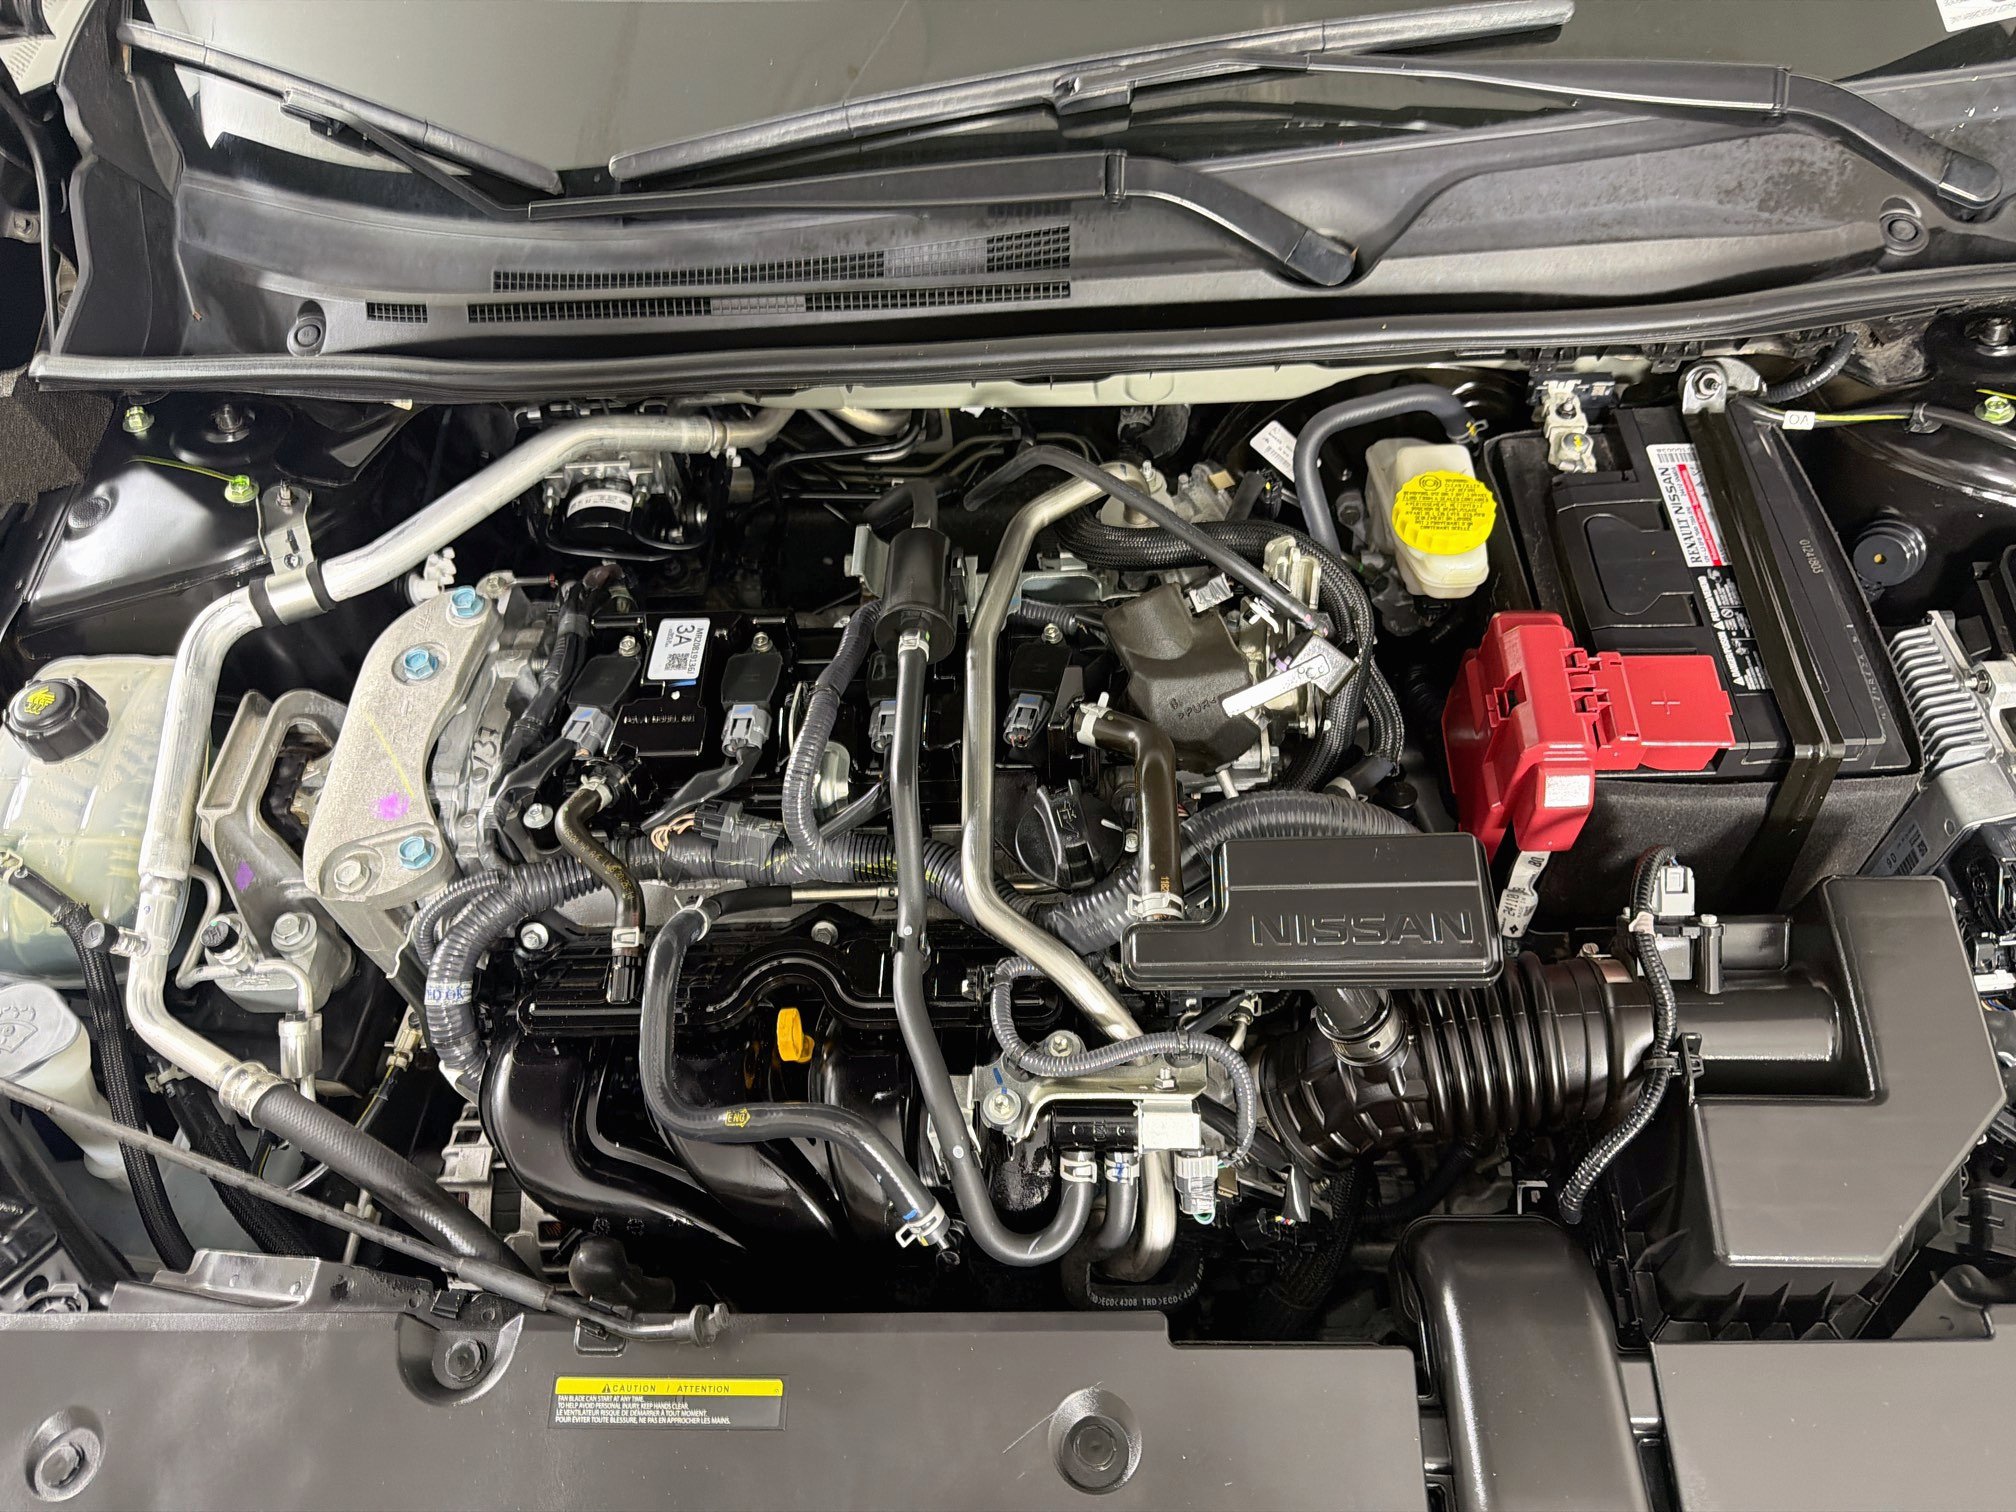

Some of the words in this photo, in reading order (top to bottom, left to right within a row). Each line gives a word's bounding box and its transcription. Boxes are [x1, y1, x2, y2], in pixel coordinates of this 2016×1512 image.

[1658, 467, 1685, 515] NISSAN
[1677, 518, 1702, 564] RENAULT
[673, 624, 695, 647] 3A
[1250, 910, 1475, 946] NISSAN
[612, 1384, 656, 1393] CAUTION
[676, 1385, 730, 1393] ATTENTION
[565, 1402, 579, 1410] HELP
[579, 1402, 595, 1410] AVOID
[595, 1402, 620, 1410] PERSONAL
[641, 1402, 653, 1410] KEEP
[653, 1402, 671, 1410] HANDS
[555, 1416, 571, 1424] POUR
[591, 1416, 609, 1424] TOUTE
[647, 1416, 658, 1424] PAS
[667, 1416, 700, 1424] APPROCHER
[701, 1416, 711, 1424] LES
